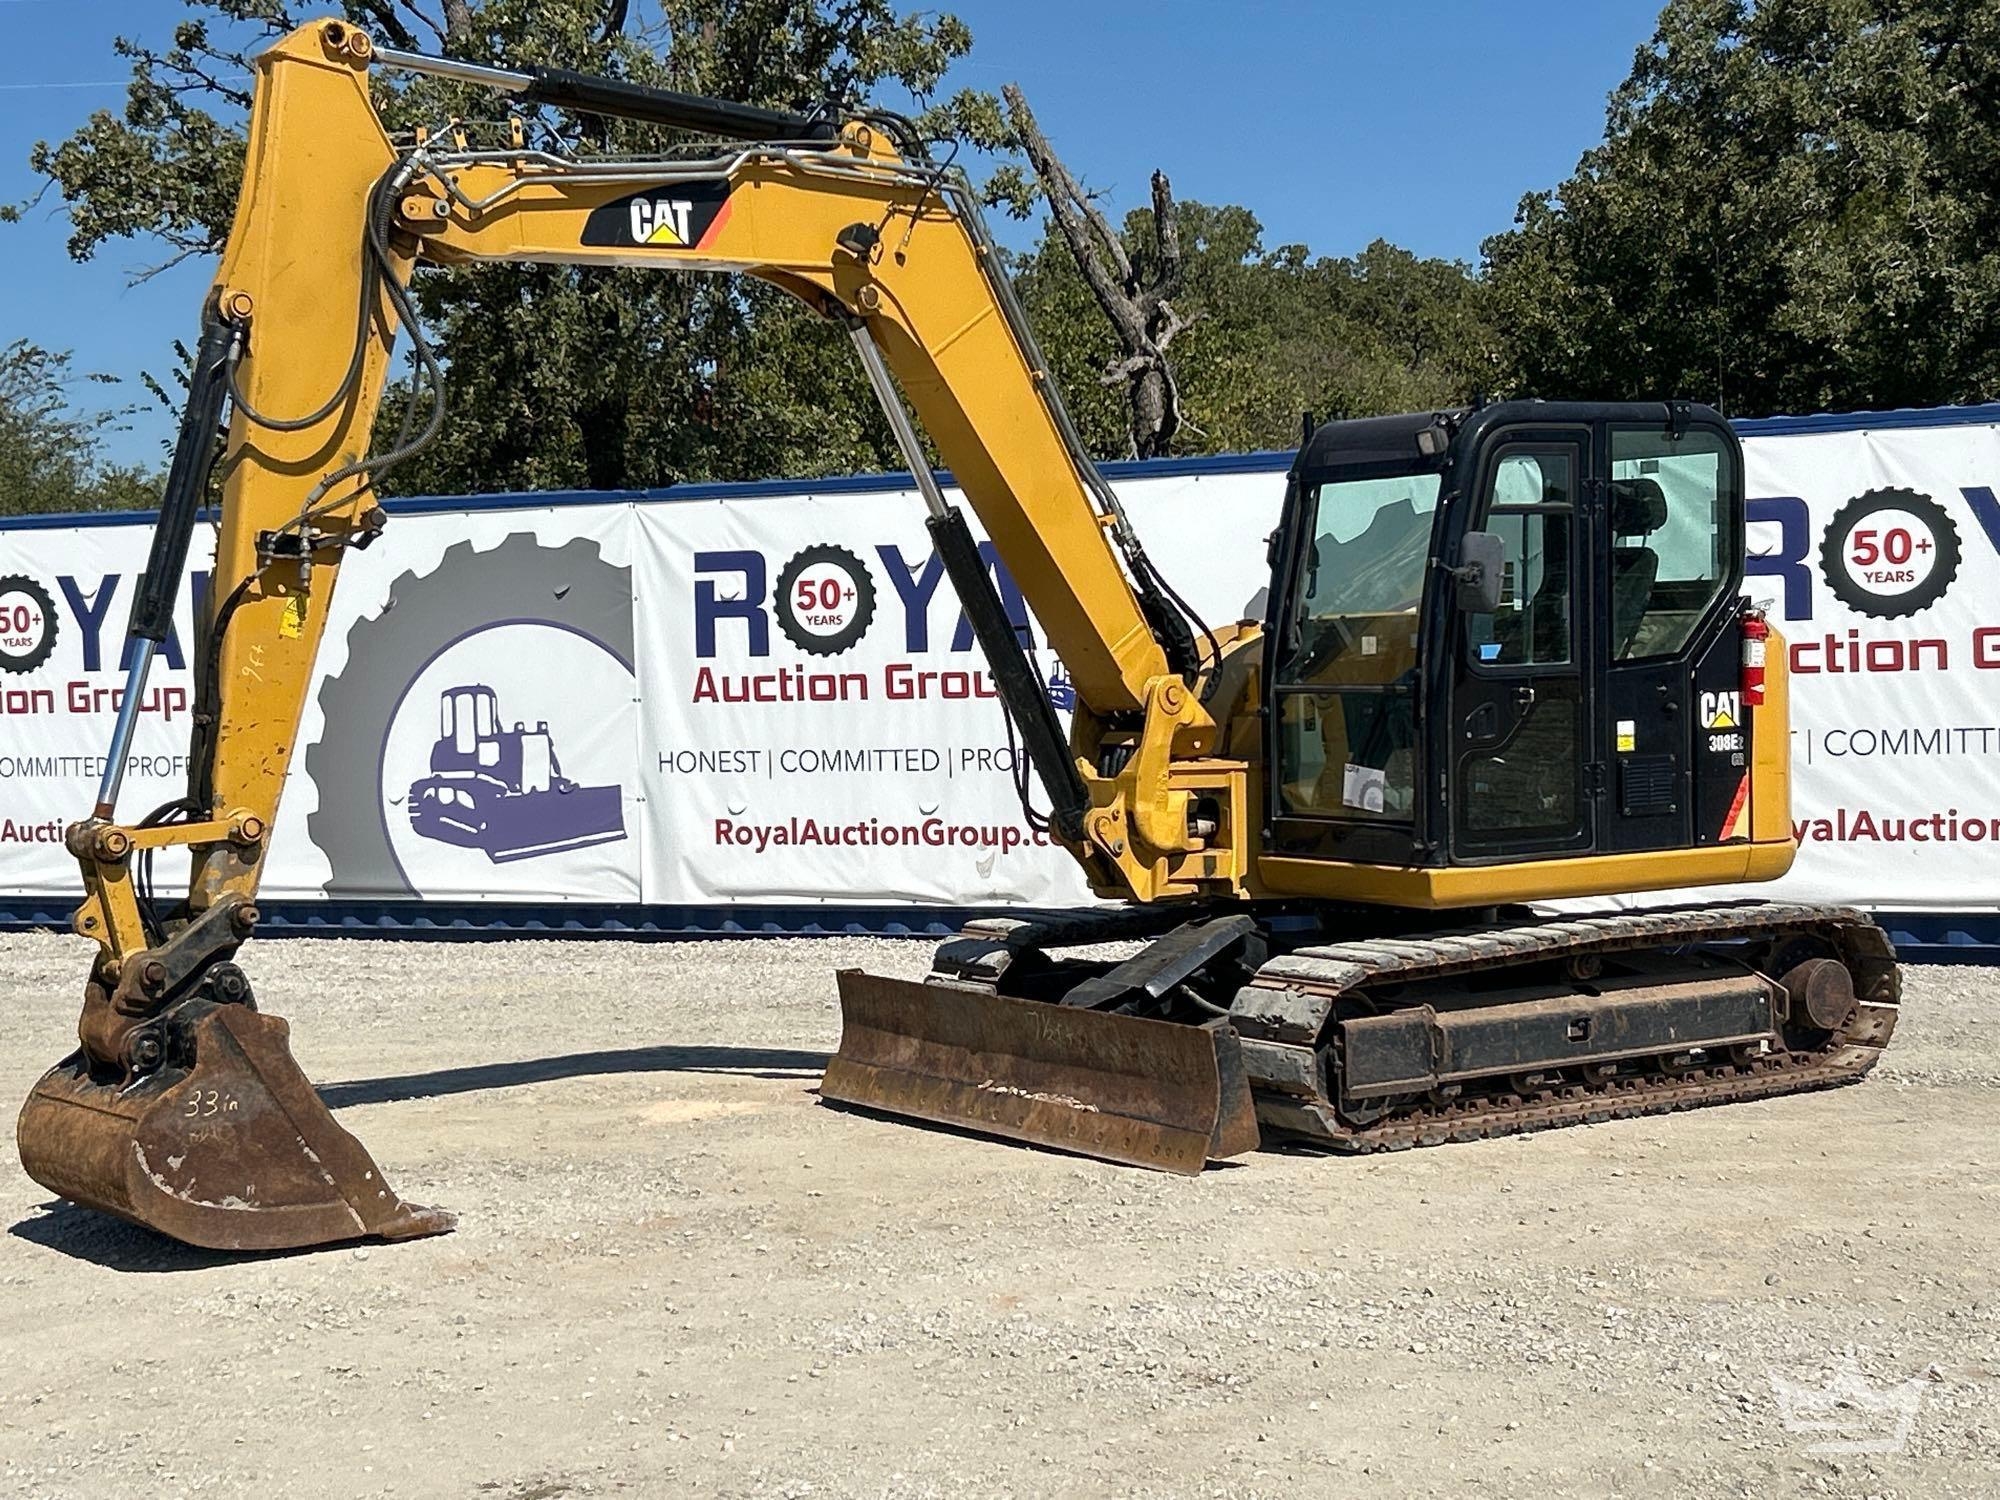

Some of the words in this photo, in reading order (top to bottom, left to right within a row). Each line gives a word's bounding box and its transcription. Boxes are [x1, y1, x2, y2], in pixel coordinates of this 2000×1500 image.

[630, 197, 692, 245] CAT
[1851, 528, 1933, 566] 50+
[1863, 570, 1915, 583] YEARS
[694, 540, 1054, 660] ROYA
[796, 578, 855, 611] 50+
[0, 605, 42, 634] 50+
[806, 614, 843, 626] YEARS
[3, 637, 33, 647] YEARS
[692, 664, 868, 703] Auction
[1700, 691, 1741, 729] CAT
[1824, 728, 2000, 756] COMMITT
[658, 750, 761, 774] HONEST
[780, 748, 940, 773] COMMITTED
[714, 817, 1063, 856] RoyalAuctionGroup.c
